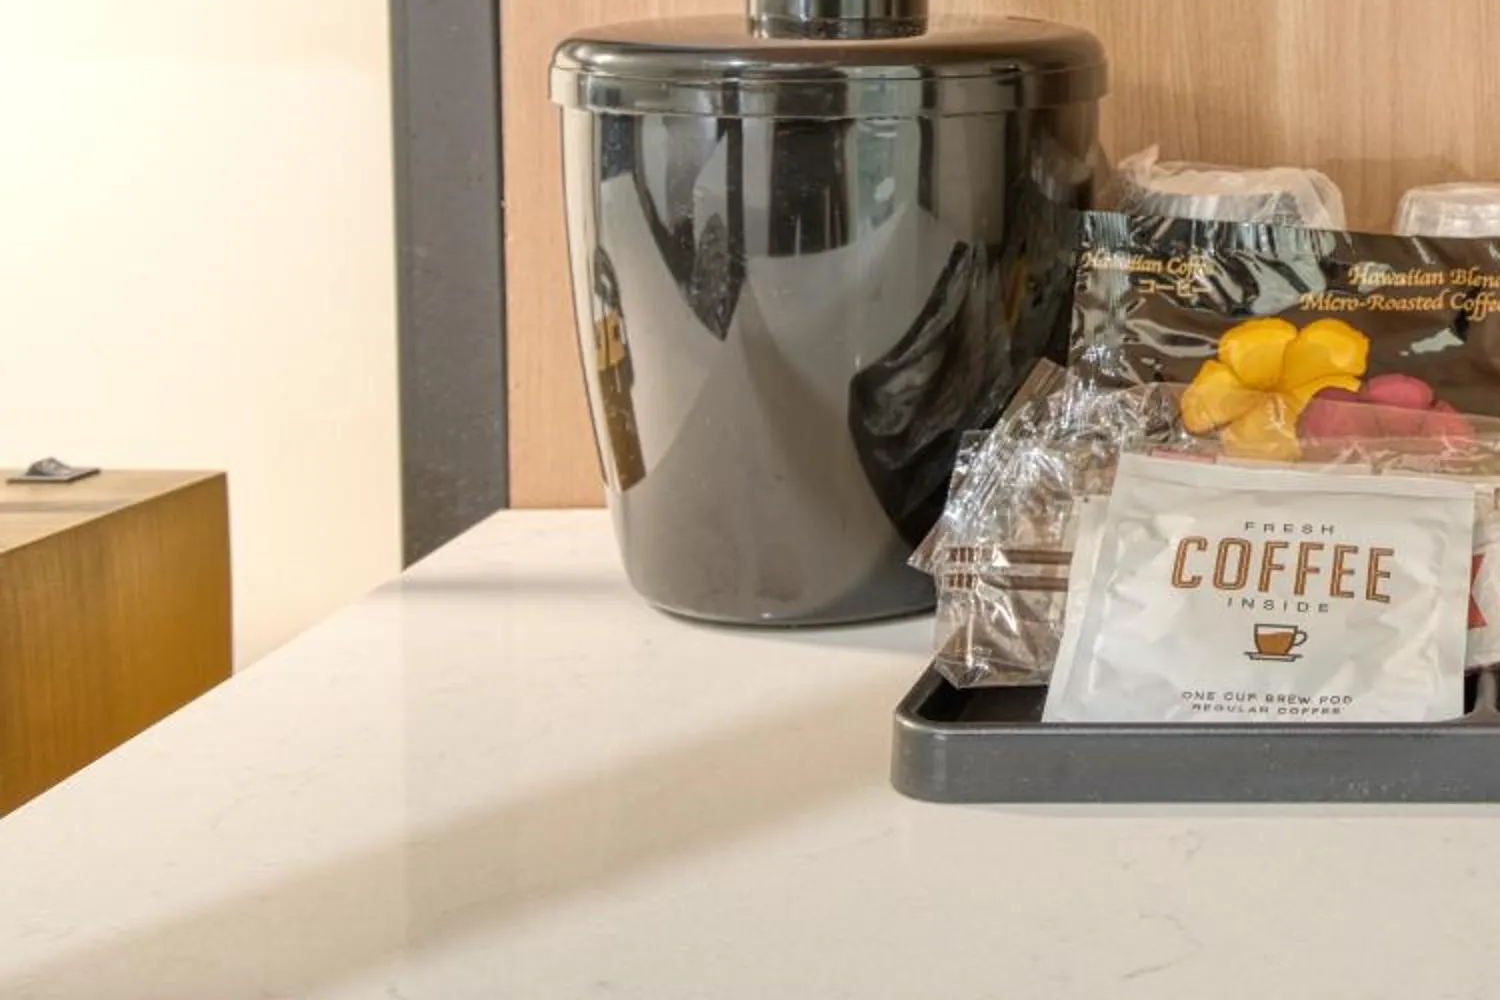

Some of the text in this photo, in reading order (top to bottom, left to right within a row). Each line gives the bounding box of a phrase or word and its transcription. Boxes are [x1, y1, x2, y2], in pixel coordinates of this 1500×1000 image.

[1348, 263, 1444, 287] Hawaiian
[1299, 288, 1450, 313] Micro-Roasted
[1244, 521, 1335, 536] FRESH
[1171, 535, 1395, 604] COFFEE
[1226, 597, 1330, 613] INSIDE
[1181, 690, 1354, 705] ONE CUP BREW POD
[1192, 702, 1342, 716] REGULAR COFFEE
